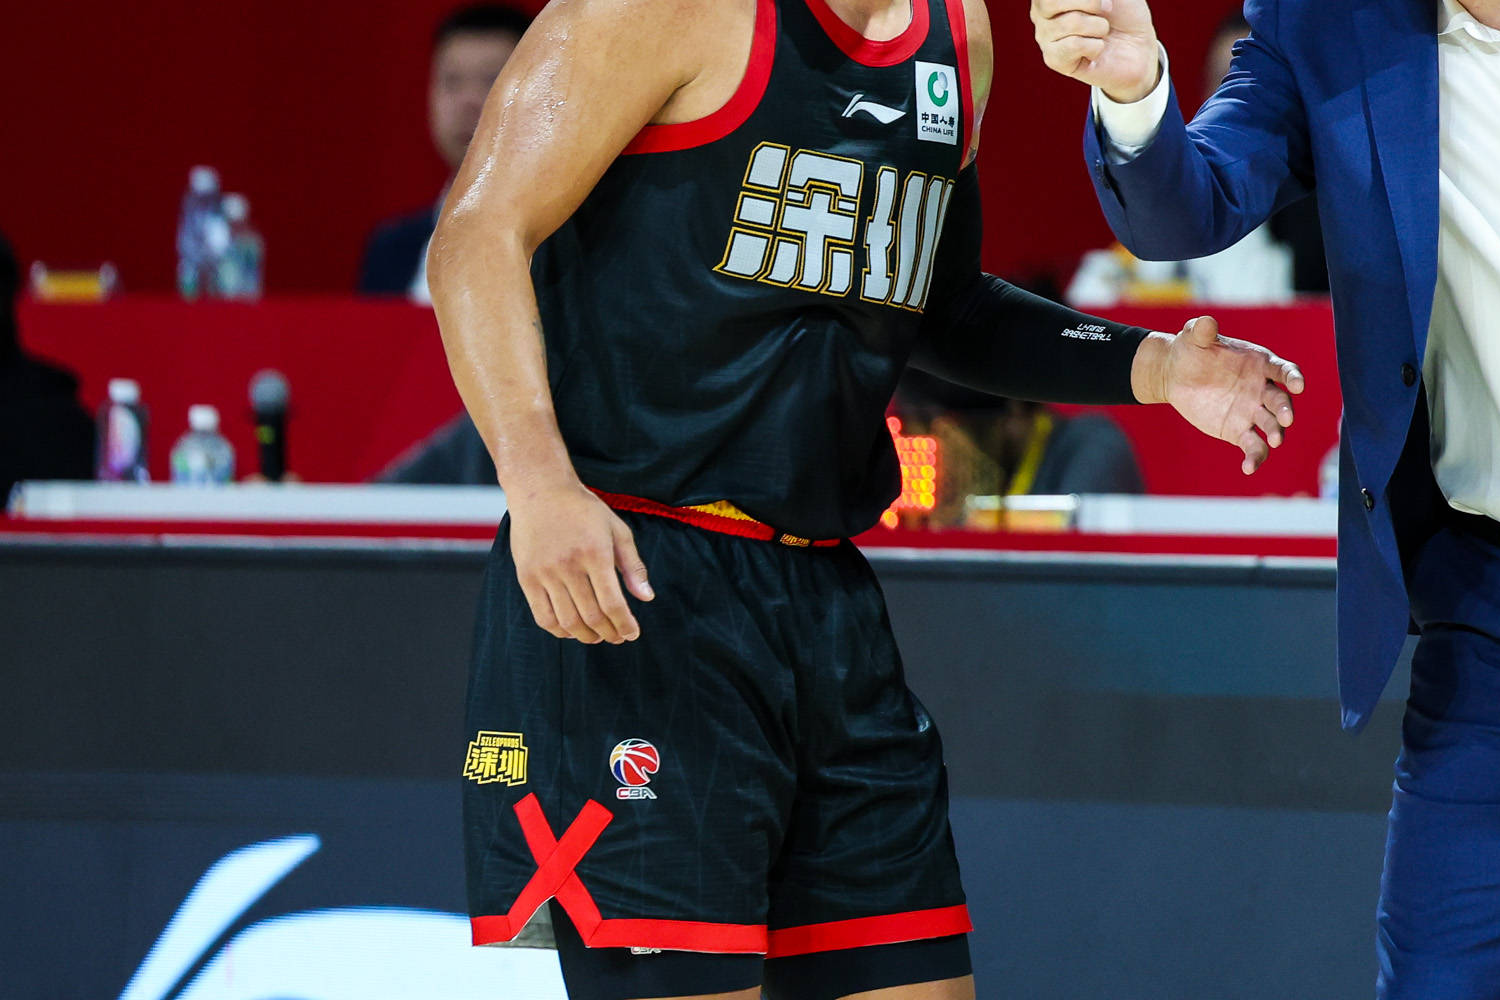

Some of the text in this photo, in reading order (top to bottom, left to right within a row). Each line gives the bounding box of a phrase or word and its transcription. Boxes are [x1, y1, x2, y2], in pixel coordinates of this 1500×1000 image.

[921, 125, 942, 134] CHINA
[1060, 328, 1112, 341] BASKETBALL
[469, 747, 524, 780] 深圳
[616, 786, 658, 800] CBA
